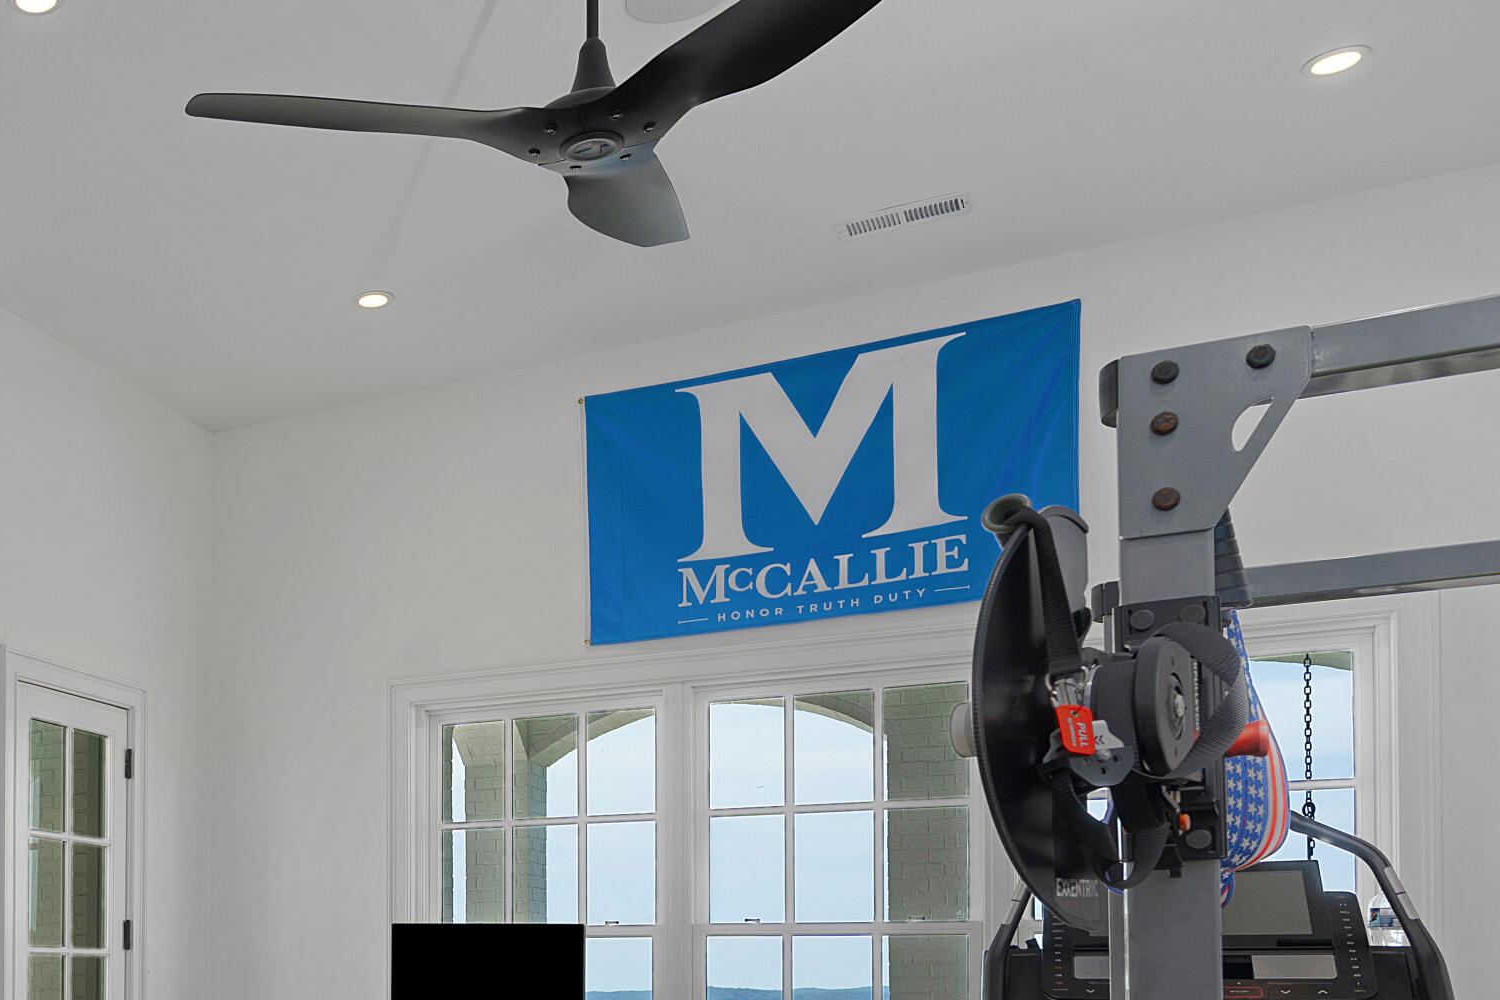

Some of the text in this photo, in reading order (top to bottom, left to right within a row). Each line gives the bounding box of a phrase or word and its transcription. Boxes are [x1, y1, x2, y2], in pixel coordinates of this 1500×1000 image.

[674, 331, 968, 563] M
[717, 587, 927, 623] HONOR TRUTH DUTY
[1076, 721, 1090, 748] PULL
